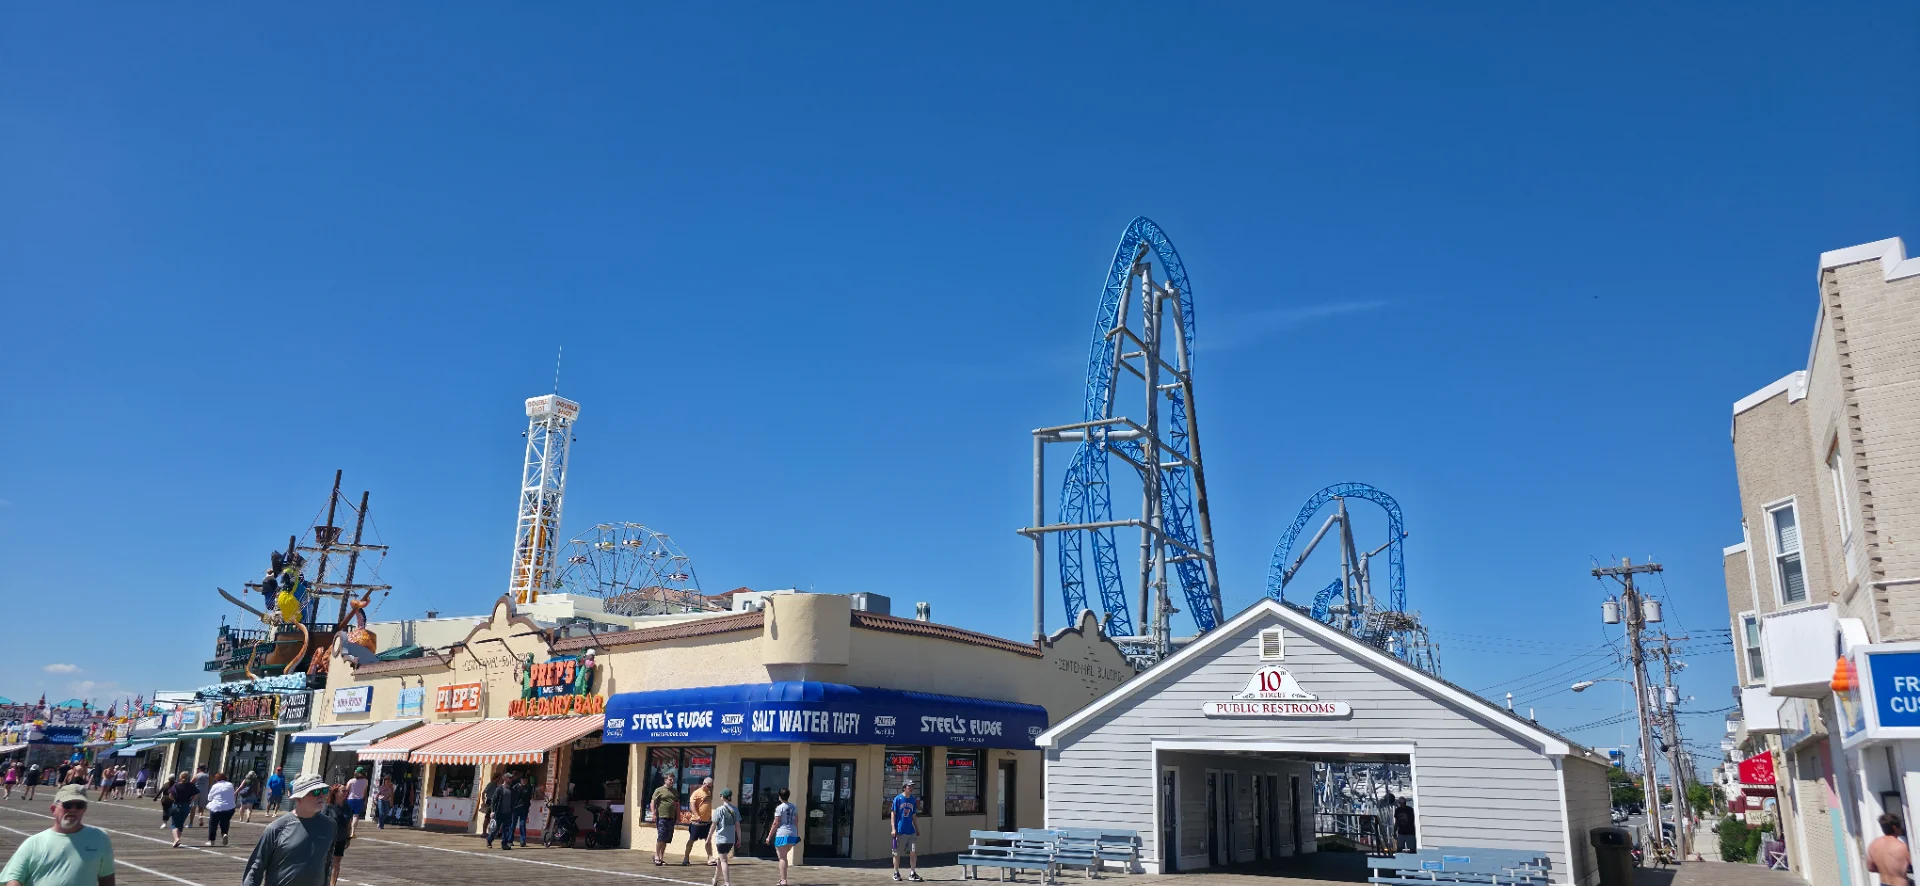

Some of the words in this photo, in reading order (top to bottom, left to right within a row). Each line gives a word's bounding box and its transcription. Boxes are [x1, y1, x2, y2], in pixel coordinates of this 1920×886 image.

[529, 660, 576, 688] PREP'S
[1893, 676, 1920, 693] FR
[436, 686, 480, 709] PEPS
[527, 697, 537, 716] &
[537, 694, 574, 715] DAIRY
[574, 692, 604, 714] BAR
[1216, 703, 1259, 713] PUBLIC
[1262, 703, 1336, 713] RESTROOMS
[1890, 696, 1920, 713] CU
[631, 710, 674, 730] STEEL'S
[677, 710, 714, 729] FUDGE
[751, 710, 777, 732] SALT
[779, 710, 829, 732] WATER
[832, 712, 861, 735] TAFFY
[920, 715, 966, 734] STEEL'S
[969, 720, 1003, 737] FUDGE
